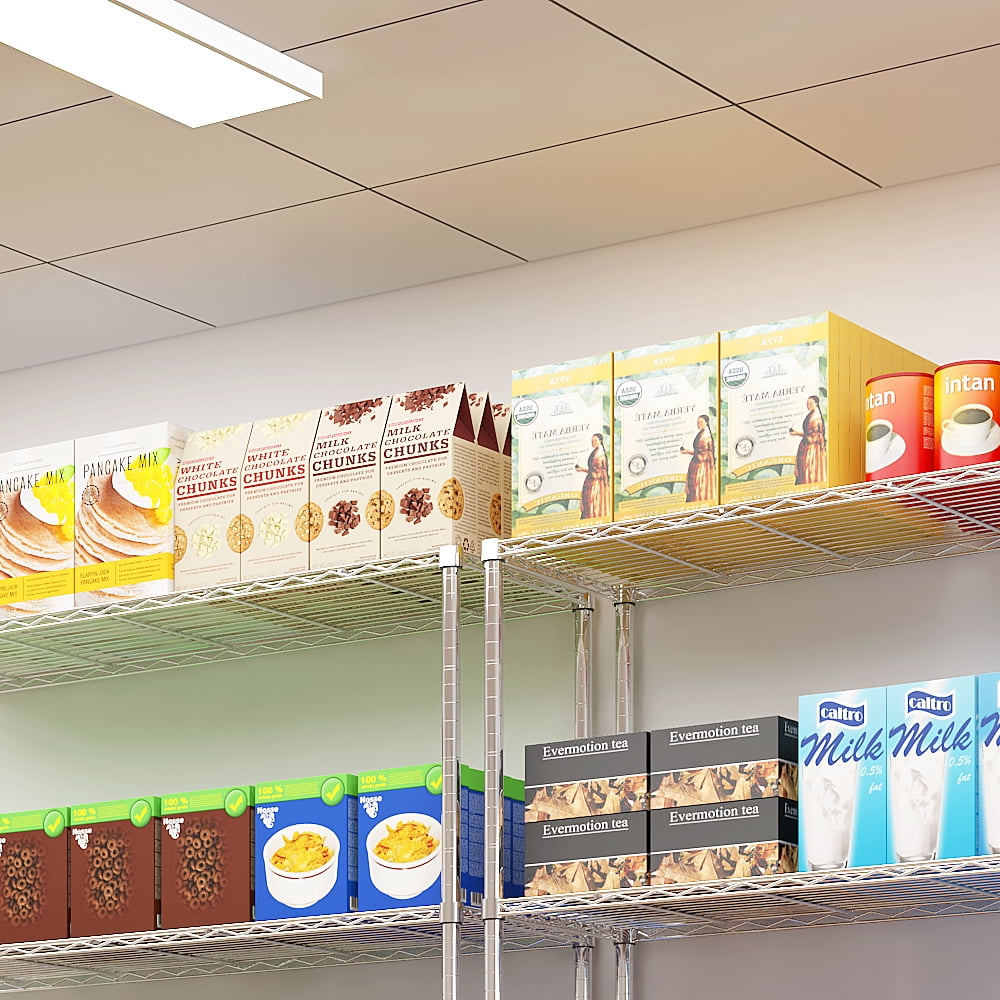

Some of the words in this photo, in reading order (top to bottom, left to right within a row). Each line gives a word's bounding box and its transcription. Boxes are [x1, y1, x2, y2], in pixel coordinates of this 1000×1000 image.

[944, 375, 996, 394] intan
[384, 428, 450, 446] CHOCOLATE
[387, 424, 422, 437] MILK
[313, 441, 378, 459] CHOCOLATE
[316, 437, 350, 450] MILK
[383, 438, 449, 459] CHUNKS
[244, 454, 307, 471] CHOCOLATE
[247, 448, 290, 463] WHITE
[312, 451, 376, 472] CHUNKS
[83, 456, 133, 479] PANCAKE
[139, 451, 158, 468] MIX
[180, 461, 222, 474] WHITE
[243, 464, 305, 484] CHUNKS
[46, 468, 65, 485] MIX
[177, 467, 239, 483] CHOCOLATE
[176, 476, 237, 495] CHUNKS
[908, 697, 952, 712] caltro
[820, 706, 864, 722] caltro
[669, 726, 739, 743] Evermotion
[741, 723, 759, 734] tea
[888, 717, 973, 758] Milk
[542, 741, 608, 758] Evermotion
[611, 739, 628, 750] tea
[801, 727, 884, 767] Milk
[947, 755, 971, 767] 0.5%
[860, 765, 883, 777] 0.5%
[957, 772, 972, 785] fat
[868, 782, 883, 795] fat
[669, 808, 739, 824] Evermotion
[741, 804, 759, 816] tea
[542, 819, 608, 836] Evermotion
[611, 817, 628, 829] tea
